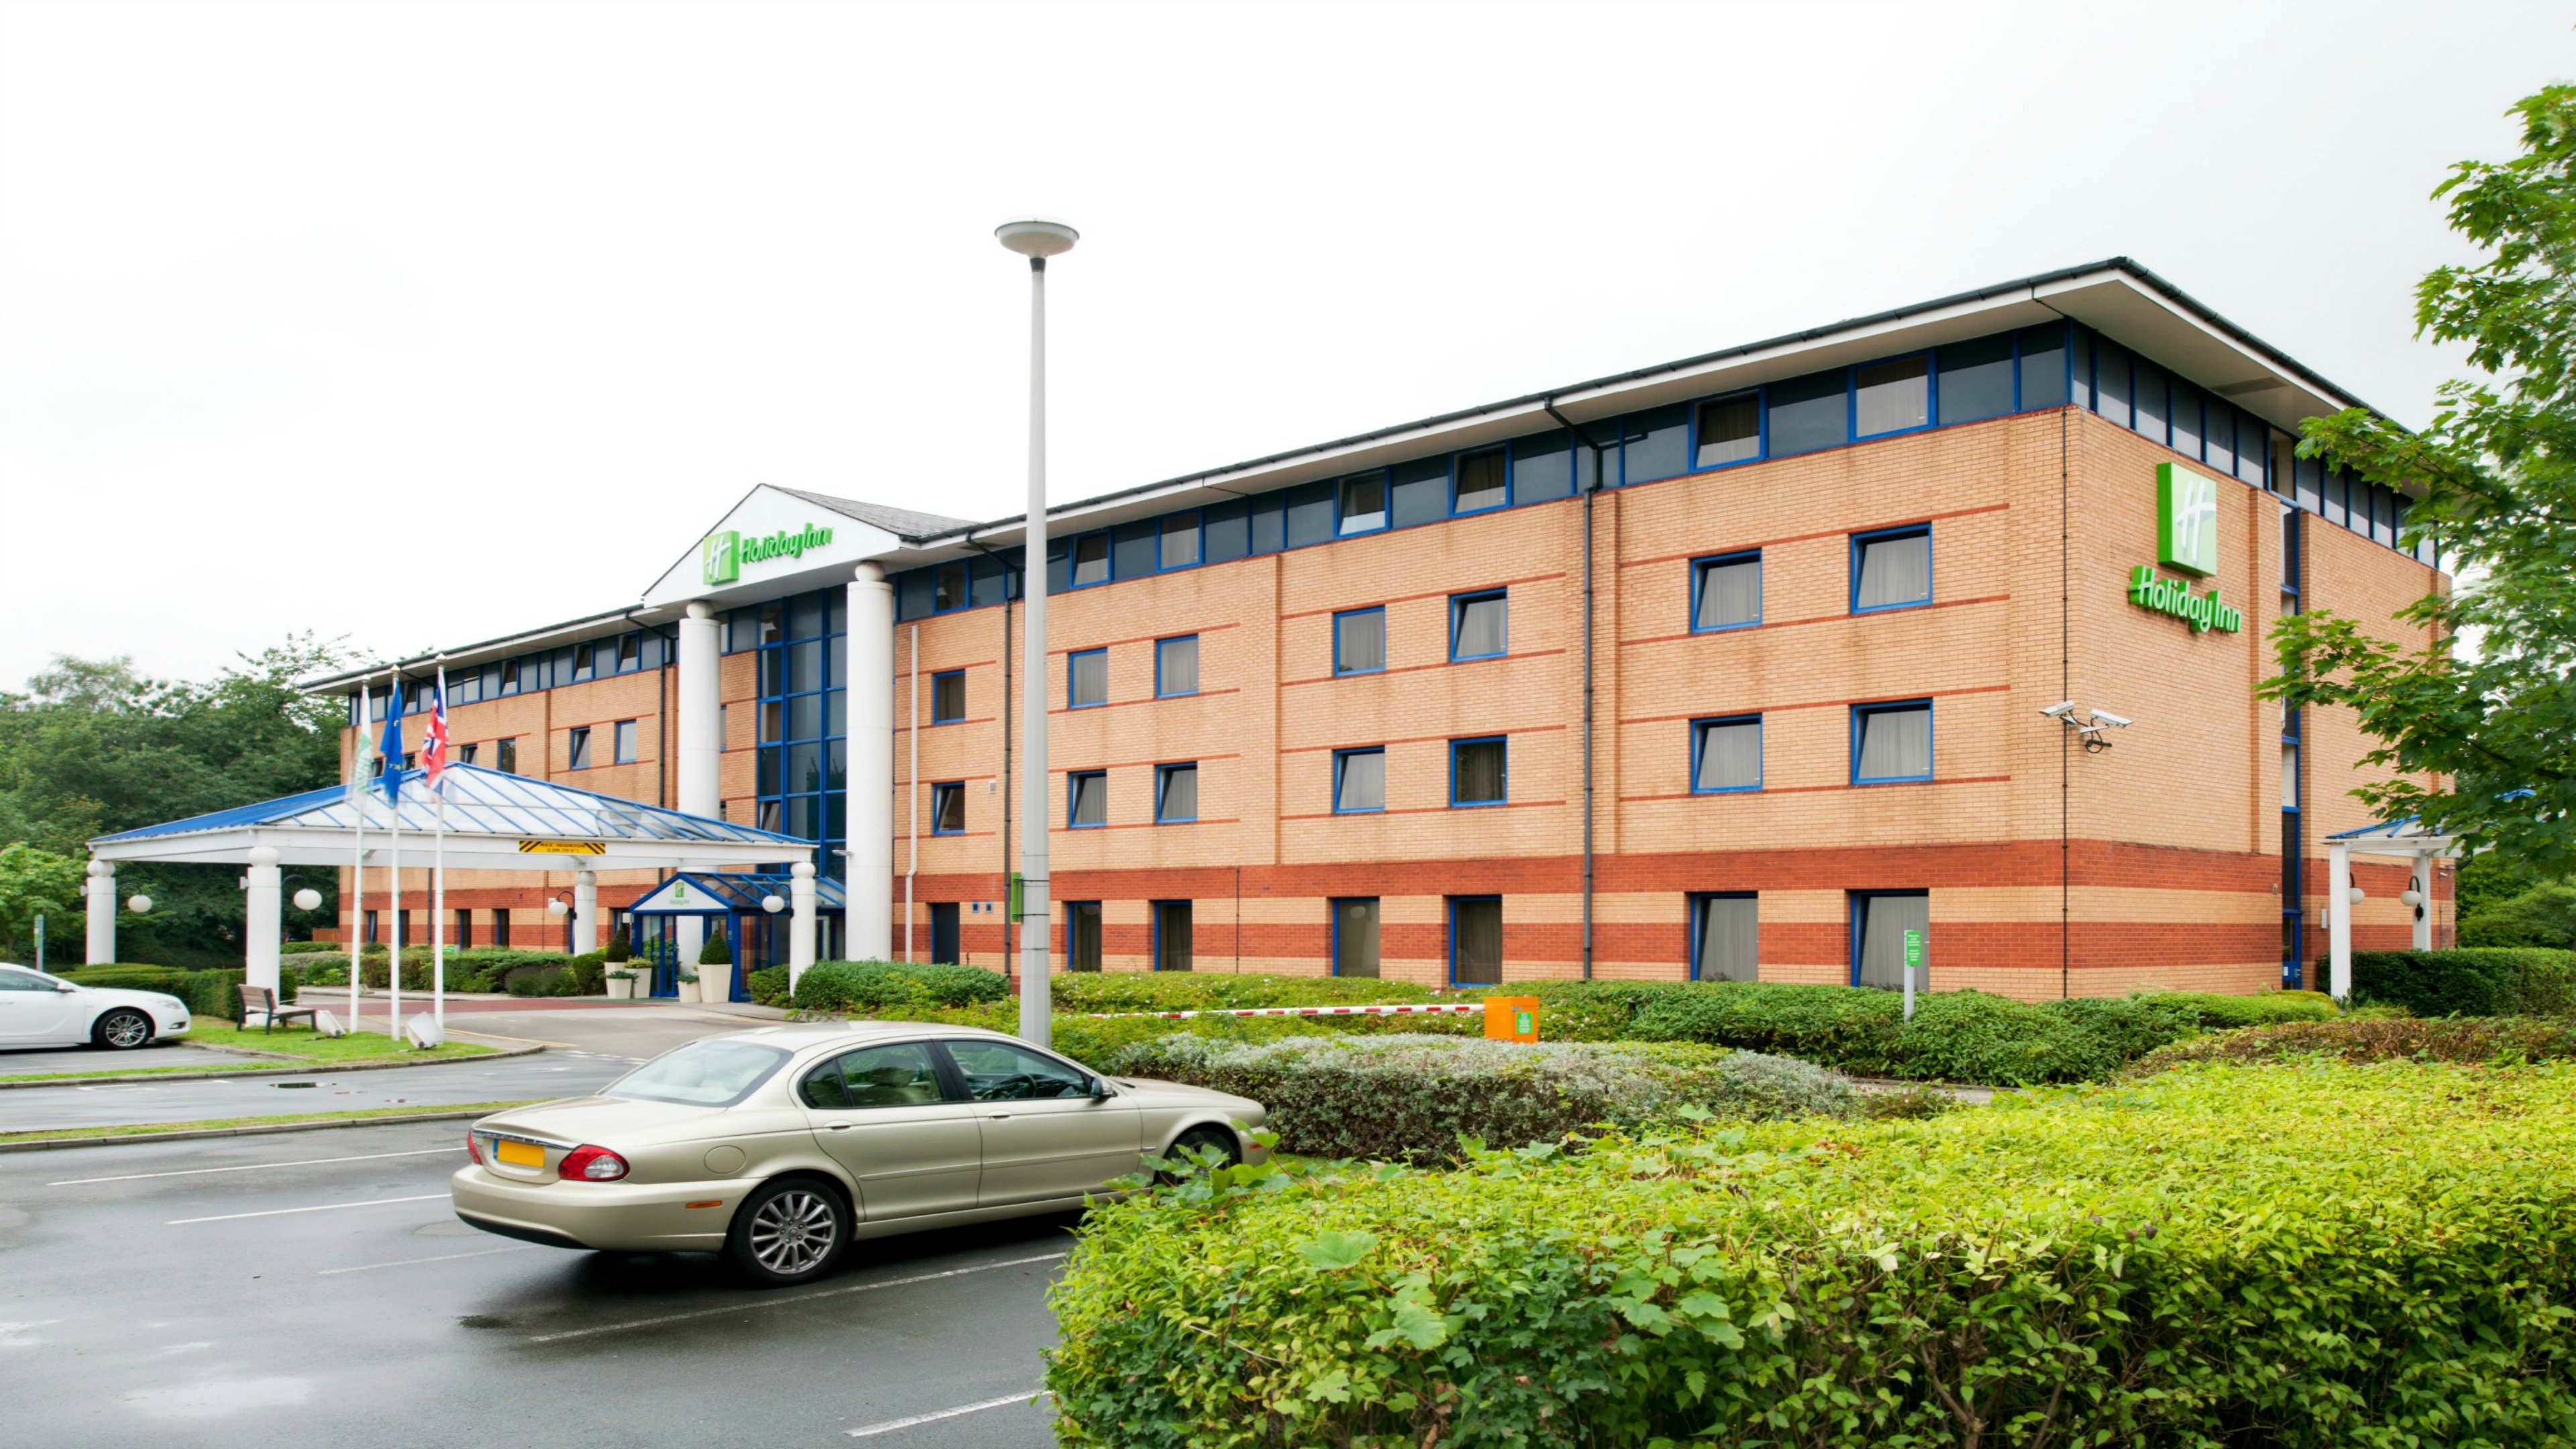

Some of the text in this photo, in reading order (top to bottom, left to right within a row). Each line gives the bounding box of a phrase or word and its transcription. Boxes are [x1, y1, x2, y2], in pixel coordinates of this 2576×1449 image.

[740, 523, 832, 564] Holiday Inn
[2128, 565, 2241, 633] Holiday Inn
